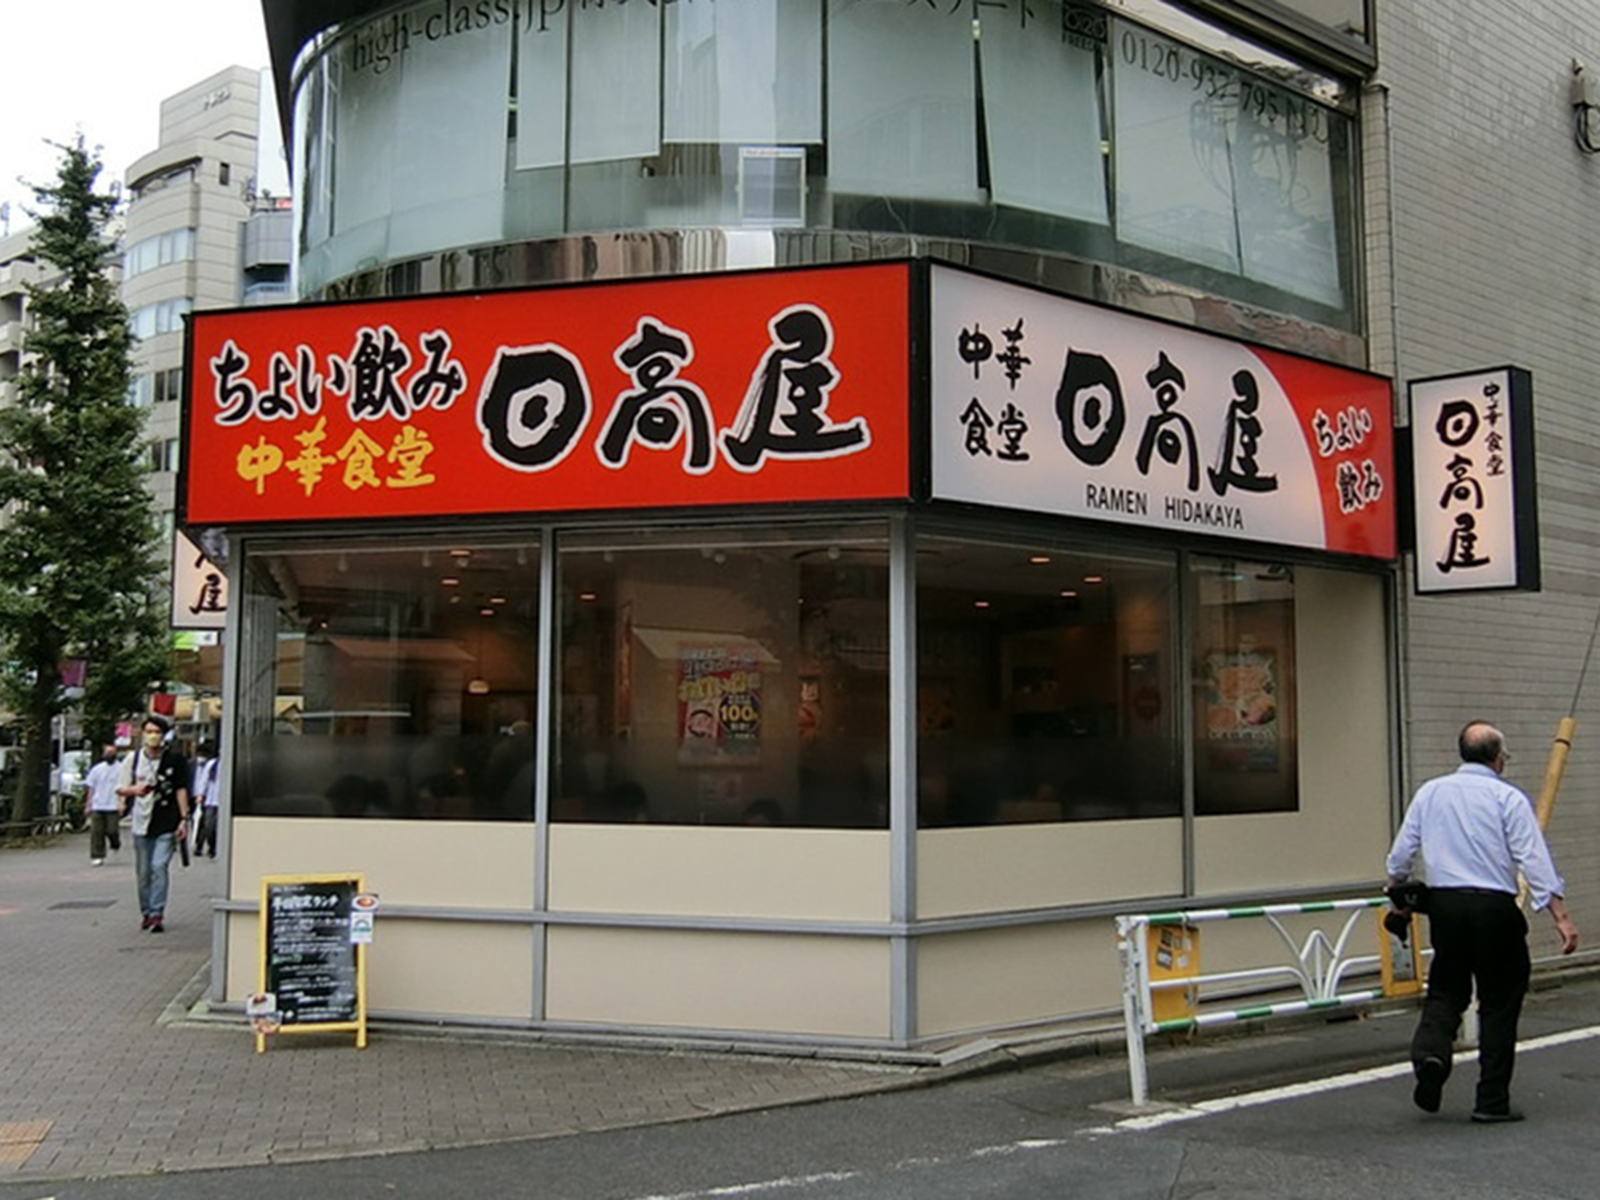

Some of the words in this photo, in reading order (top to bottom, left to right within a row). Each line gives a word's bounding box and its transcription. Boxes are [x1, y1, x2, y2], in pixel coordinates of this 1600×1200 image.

[211, 326, 467, 425] ちょい飲み
[477, 304, 870, 475] 日高屋
[957, 317, 1032, 390] 中華
[236, 416, 436, 497] 中華食堂
[958, 397, 1030, 463] 食堂
[1055, 347, 1278, 497] 日高屋
[1312, 404, 1372, 457] ちょい
[1086, 484, 1148, 516] RAMEN
[1164, 496, 1244, 531] HIDAKAYA
[1334, 460, 1382, 514] 飲み
[1436, 400, 1491, 574] 日高屋
[189, 552, 227, 615] 屋
